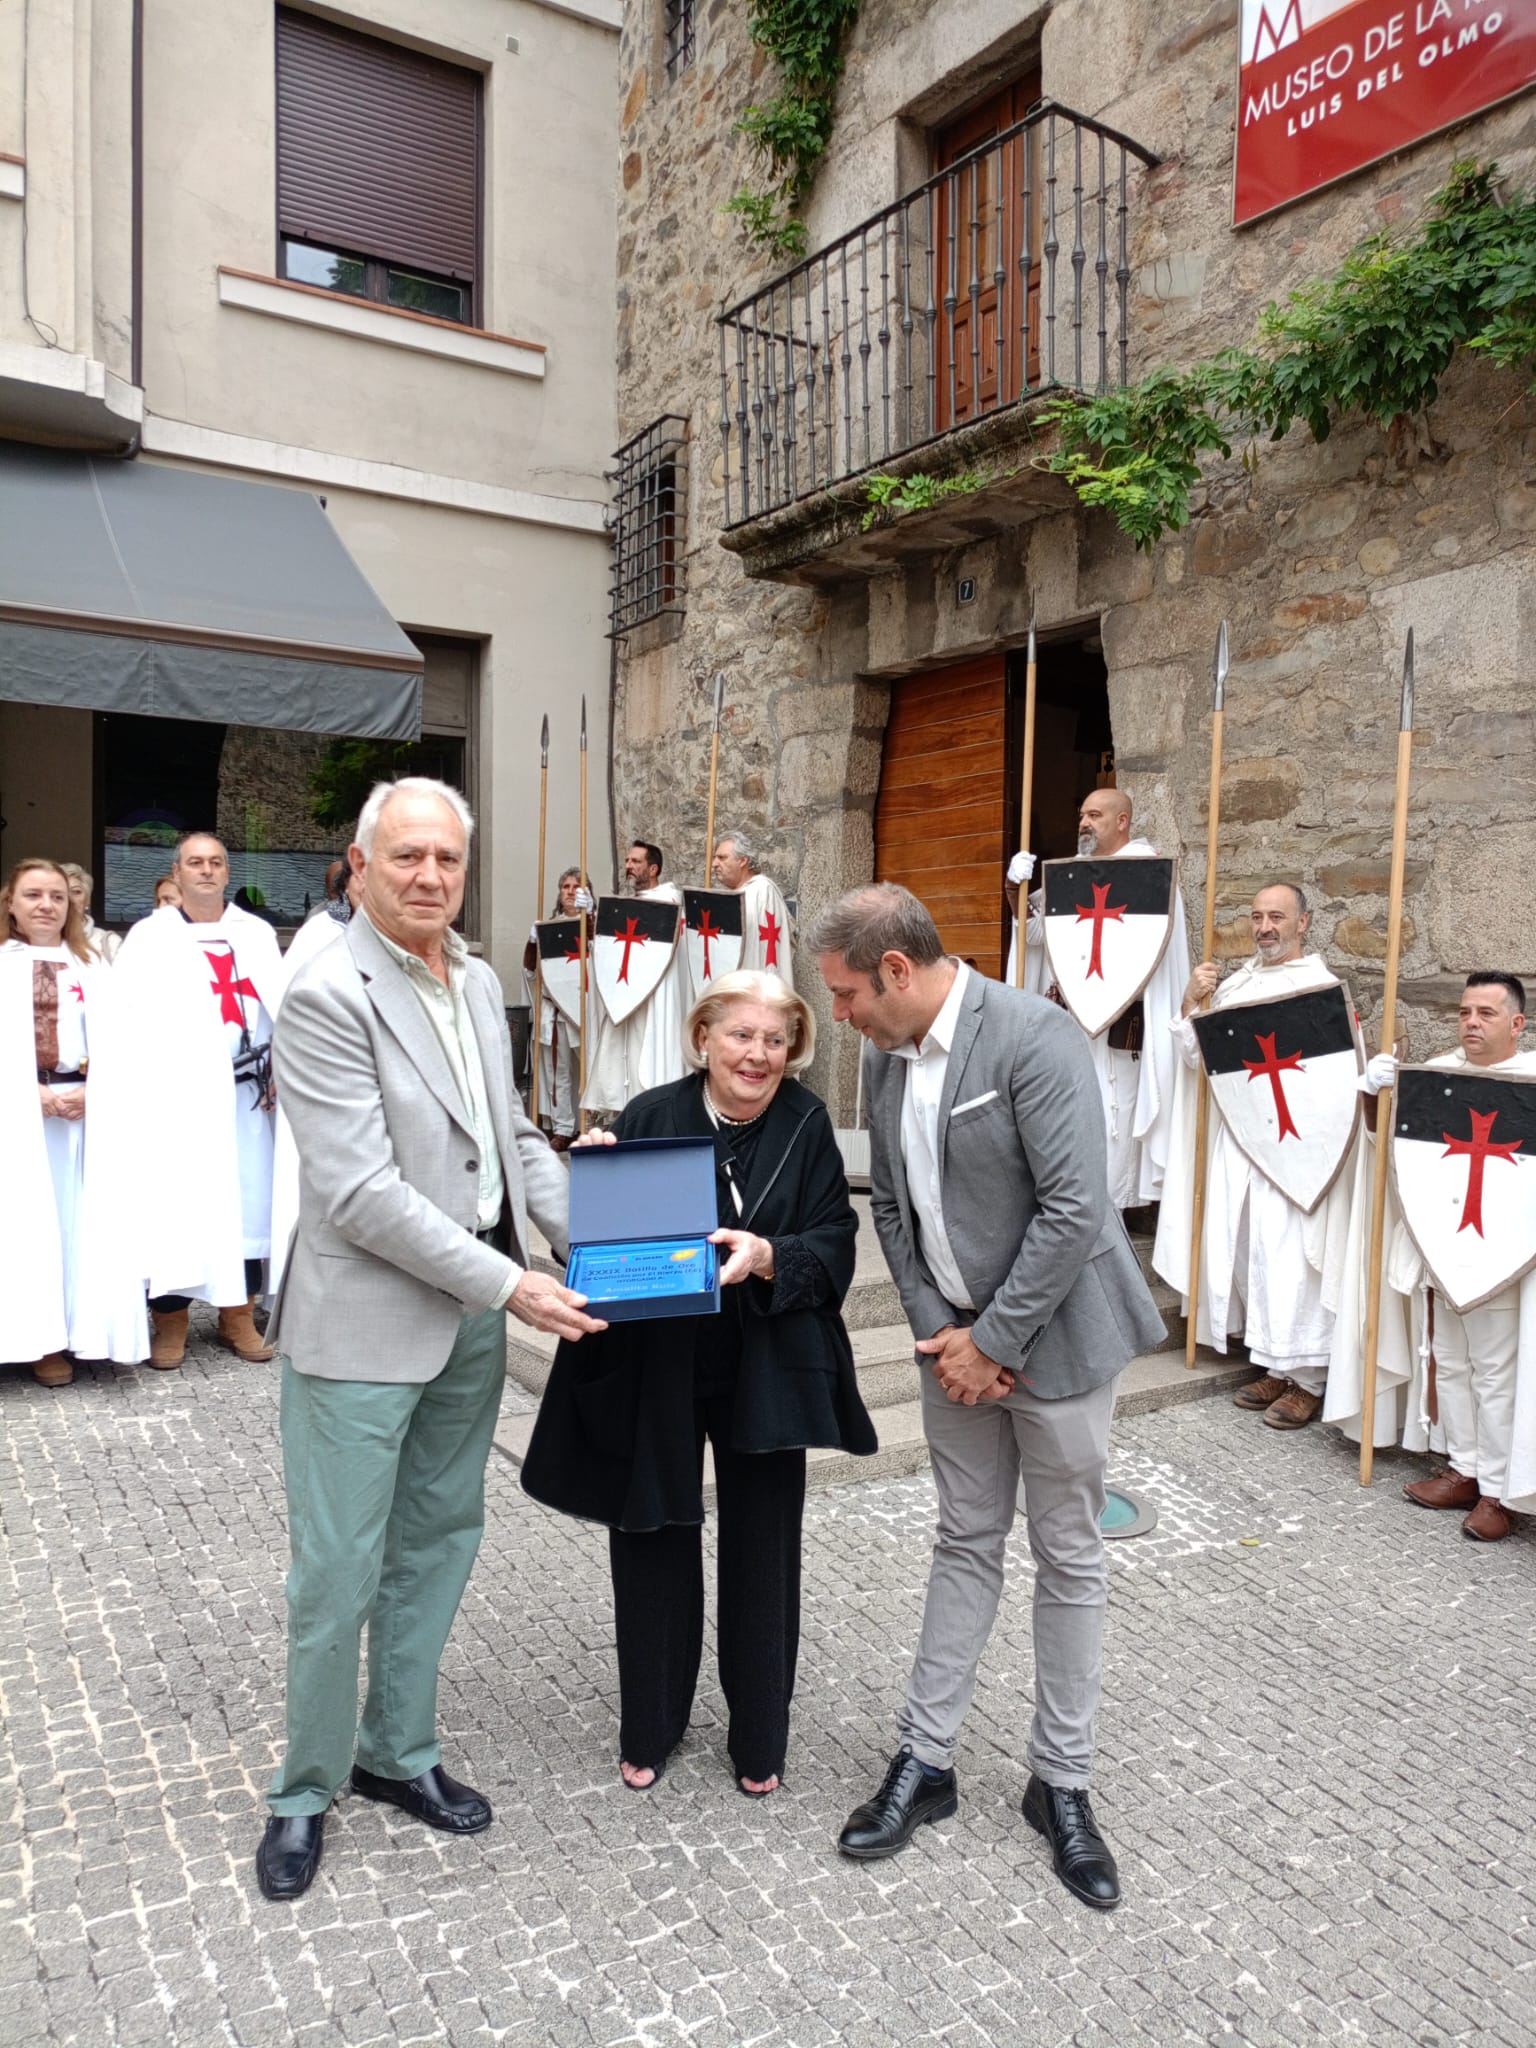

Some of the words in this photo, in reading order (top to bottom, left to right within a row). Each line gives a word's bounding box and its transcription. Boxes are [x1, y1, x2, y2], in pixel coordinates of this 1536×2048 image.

[1244, 43, 1354, 127] MUSEO
[1364, 12, 1404, 63] DE
[1416, 0, 1452, 35] LA
[1287, 92, 1342, 137] LUIS
[1357, 62, 1404, 101] DEL
[1418, 11, 1503, 67] OLMO
[964, 581, 970, 599] 7
